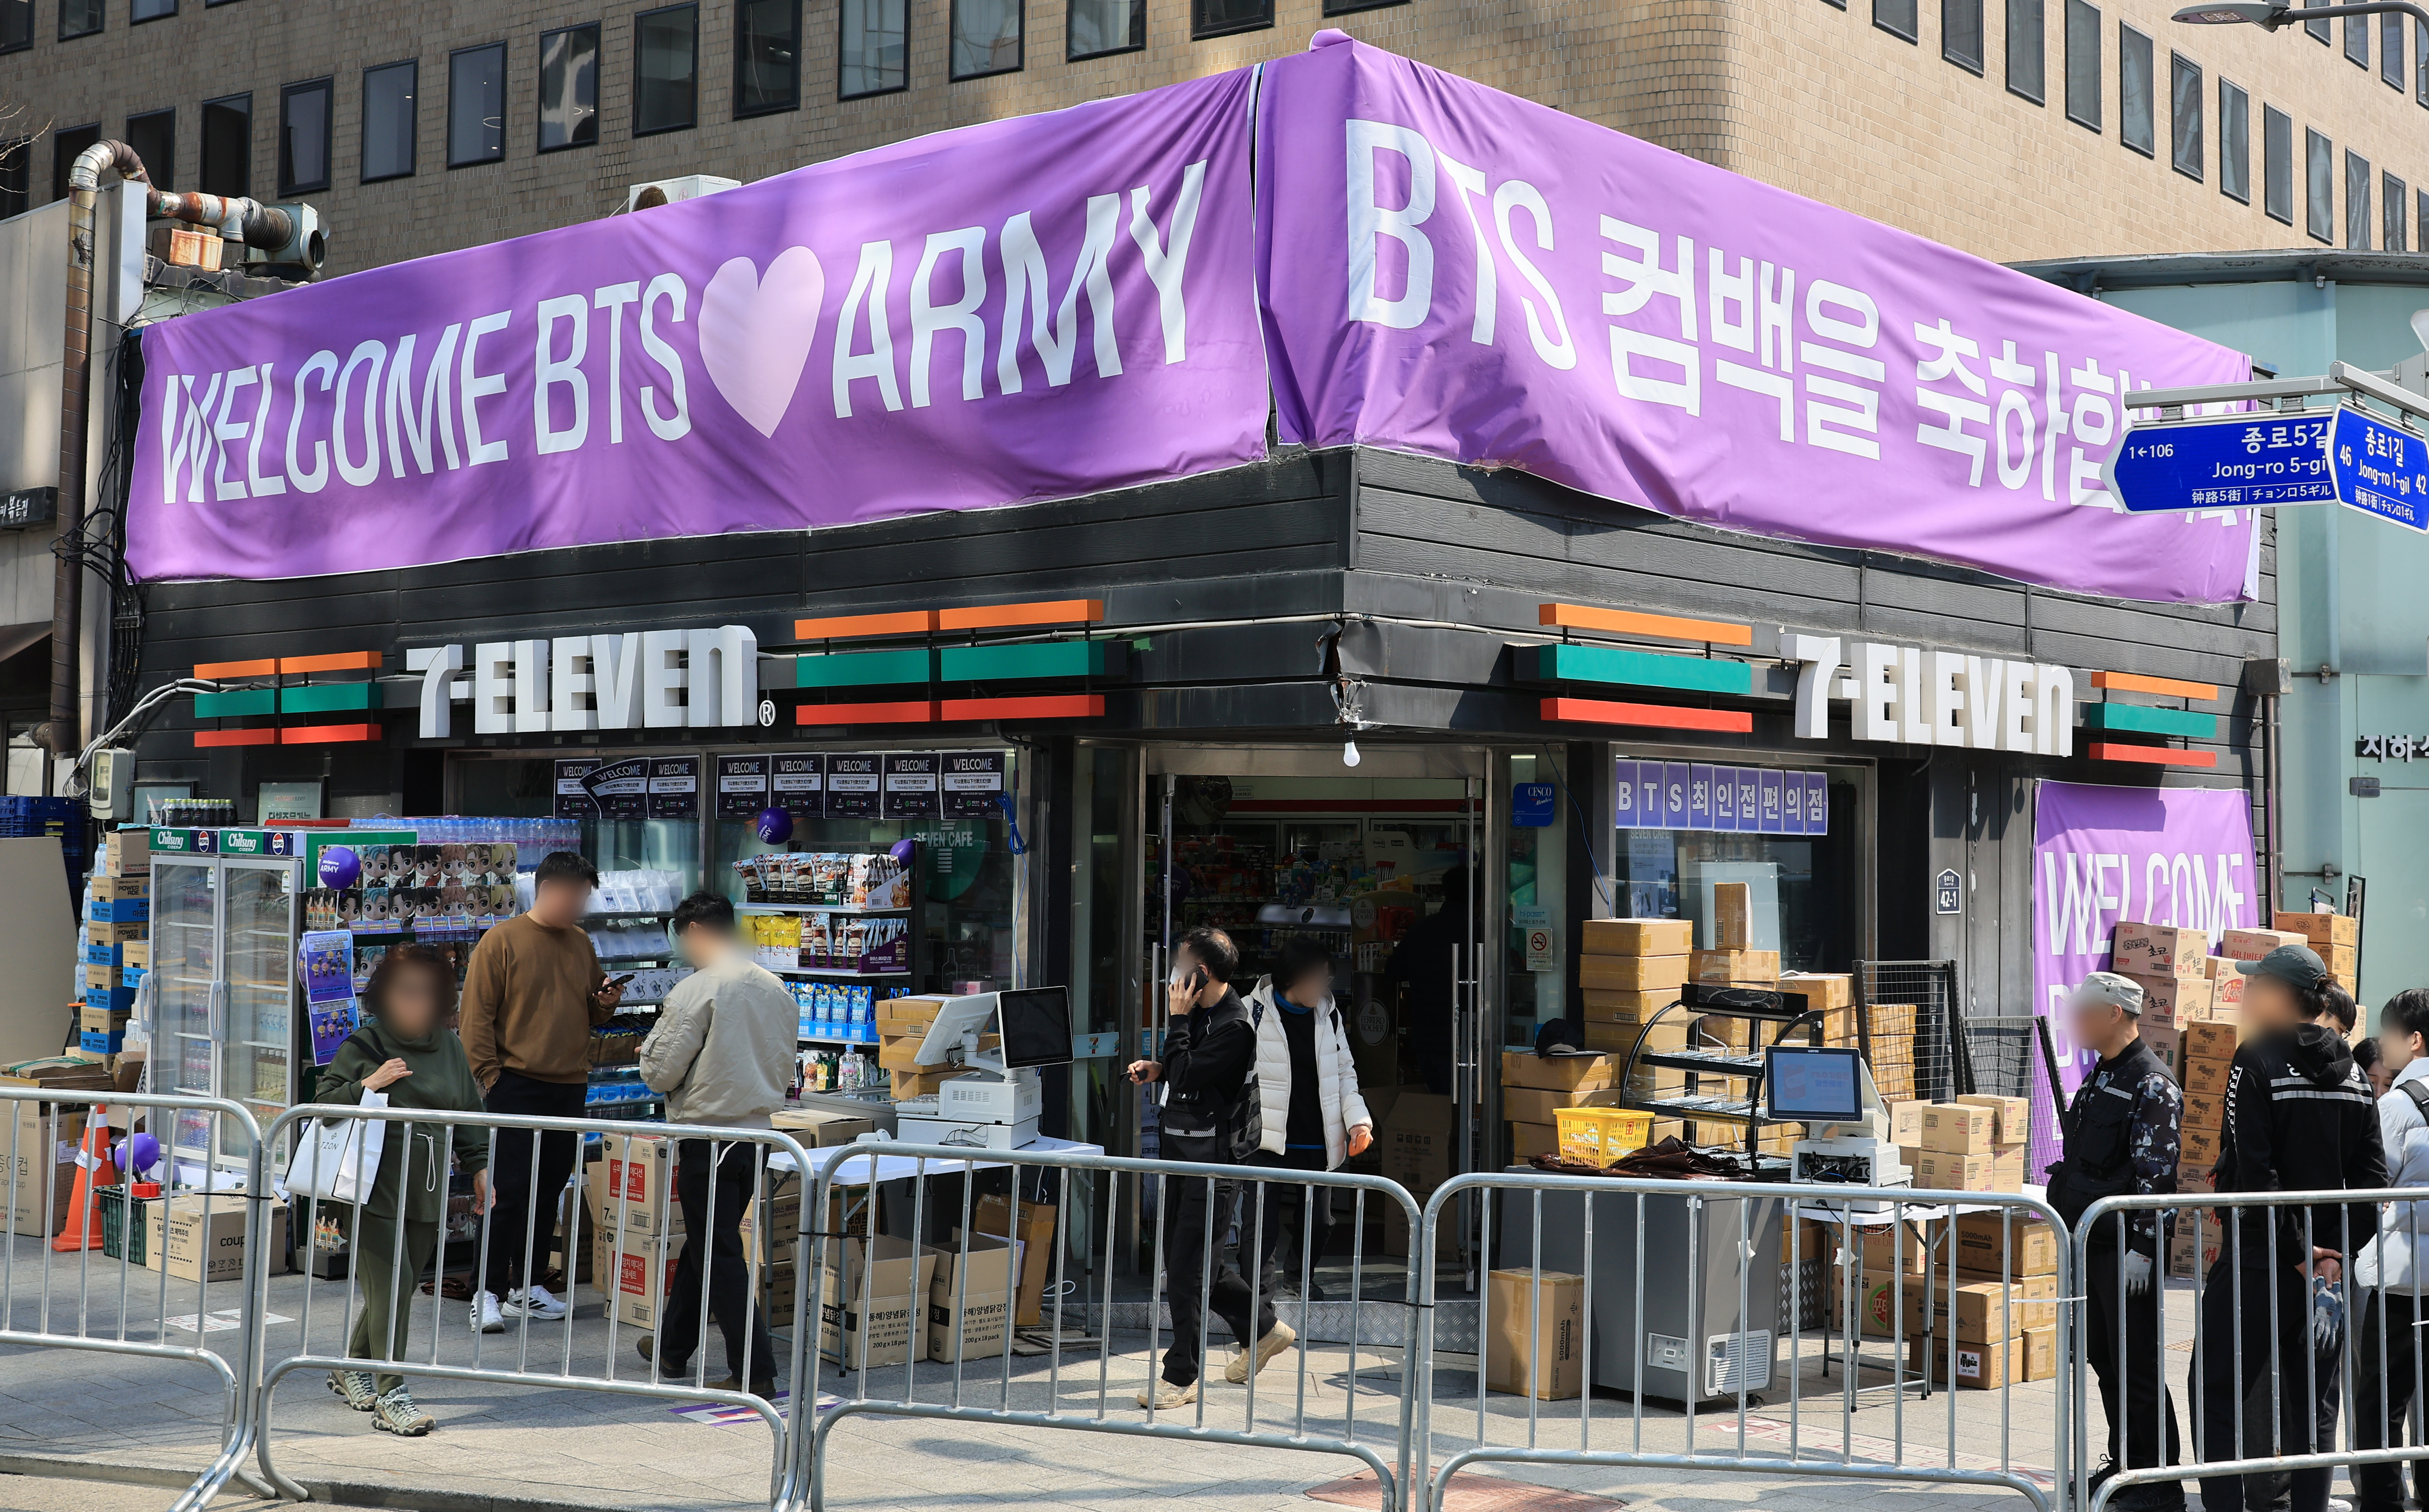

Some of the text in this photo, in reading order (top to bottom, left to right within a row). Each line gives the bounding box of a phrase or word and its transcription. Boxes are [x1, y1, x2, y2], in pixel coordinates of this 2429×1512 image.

[1345, 119, 1577, 370] BTS
[1600, 213, 1885, 461] 컴백을
[162, 159, 1207, 504] WELCOME BTS ARMY
[2241, 421, 2331, 454] 종로5길
[2150, 444, 2174, 458] 106
[2365, 426, 2403, 468] 종로1길
[2340, 444, 2352, 466] 46
[2212, 456, 2329, 479] Jong-ro 5-gi
[2358, 459, 2410, 495] Jong-ro 1-gil
[2416, 473, 2427, 495] 42
[2191, 484, 2331, 504] 钟路5街 チョンロ5ギル
[2355, 488, 2415, 521] 钟路1街 チョンロ1ギル
[658, 763, 689, 775] WELCOME
[727, 762, 760, 774] WELCOME
[779, 760, 814, 772] WELCOME
[836, 760, 872, 772] WELCOME
[894, 759, 930, 772] WELCOME
[953, 758, 993, 771] WELCOME
[595, 765, 641, 781] WELCOME
[1528, 786, 1552, 797] CESCO
[1535, 797, 1552, 806] Members
[157, 830, 183, 848] Chilsung
[948, 830, 973, 847] CAFE
[1630, 829, 1670, 839] SEVEN CAFE
[228, 832, 256, 851] Chilsung
[320, 865, 339, 873] ARMY
[1940, 891, 1956, 907] 42-1
[2044, 852, 2244, 956] WELCOME
[2148, 945, 2168, 957] 초코
[2149, 997, 2169, 1008] 초코
[1361, 1015, 1385, 1025] FERRERO
[1360, 1023, 1385, 1033] ROCHER
[629, 1167, 643, 1178] 에디션
[604, 1207, 610, 1221] 7
[220, 1235, 245, 1247] coup
[1862, 1235, 1895, 1247] BUTTER CHI
[1961, 1231, 1992, 1242] 5000mAh
[622, 1257, 643, 1271] 참치 에디션
